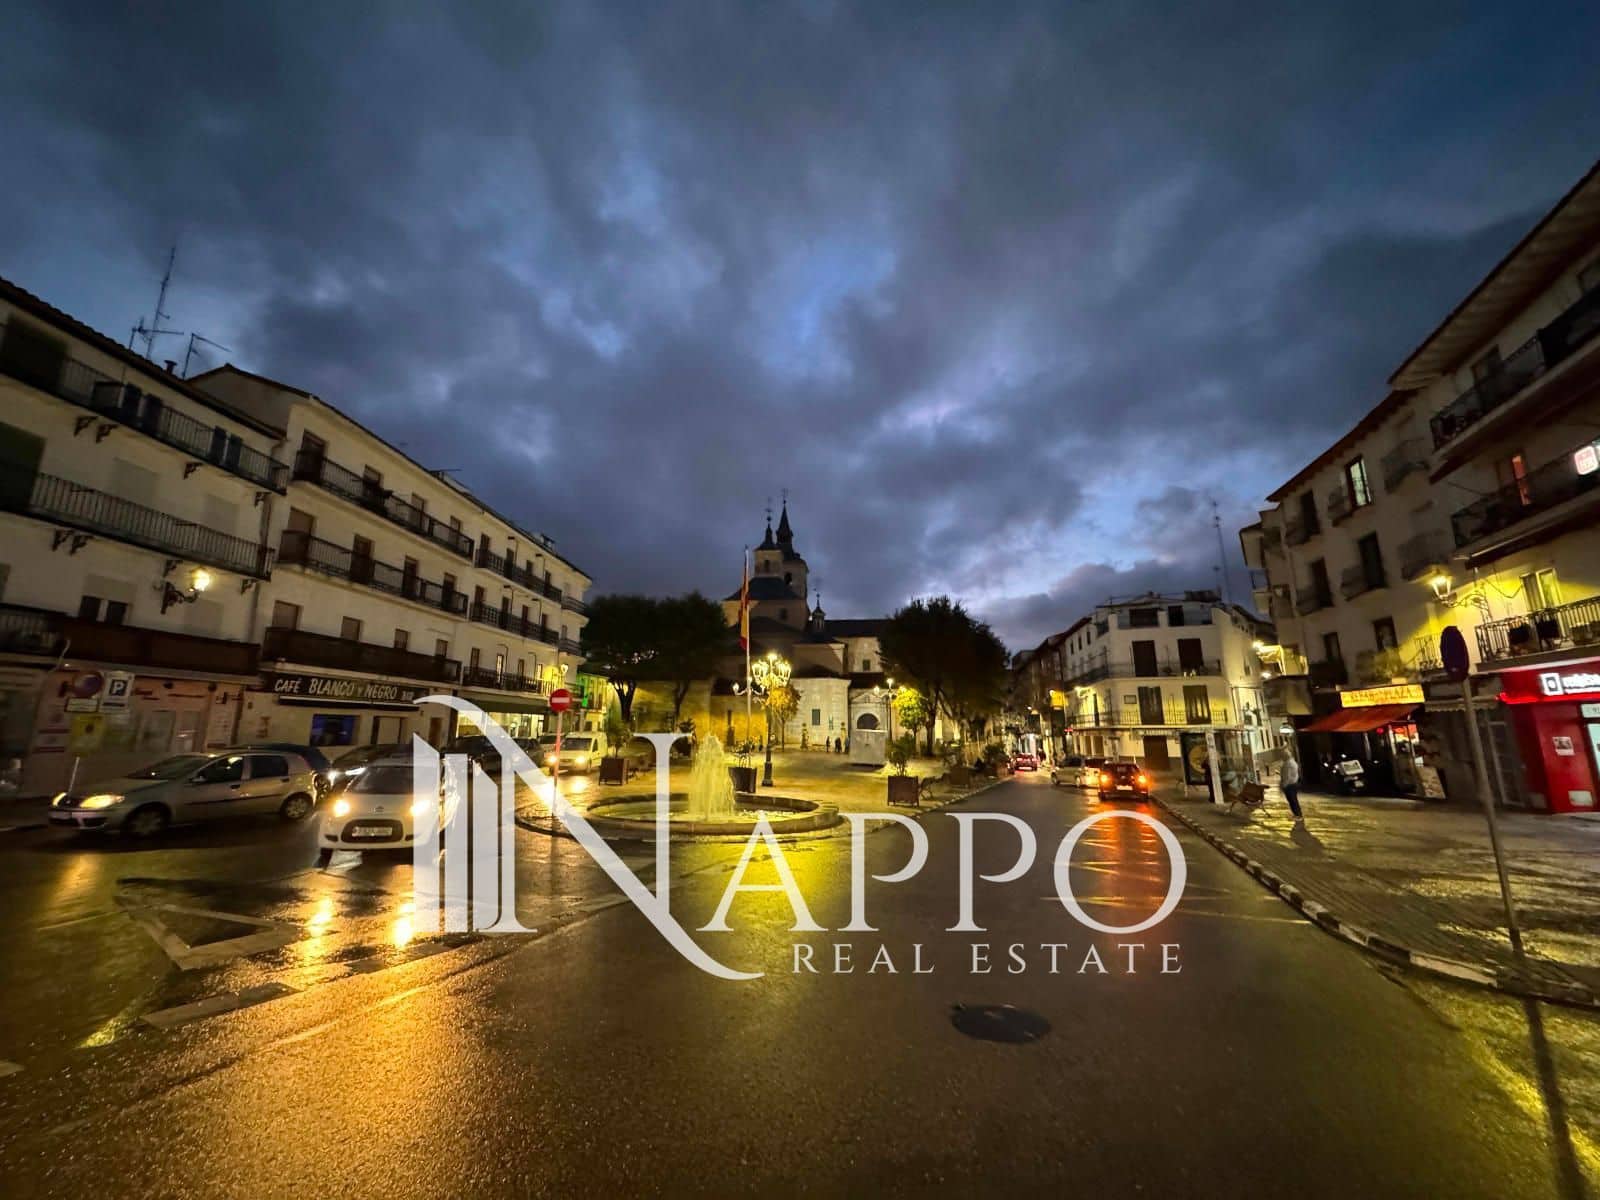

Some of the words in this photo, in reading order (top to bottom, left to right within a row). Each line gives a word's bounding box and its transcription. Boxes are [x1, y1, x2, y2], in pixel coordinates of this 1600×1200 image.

[274, 677, 300, 693] CAFÉ
[308, 677, 355, 696] BLANCO
[364, 683, 398, 700] NEGRO
